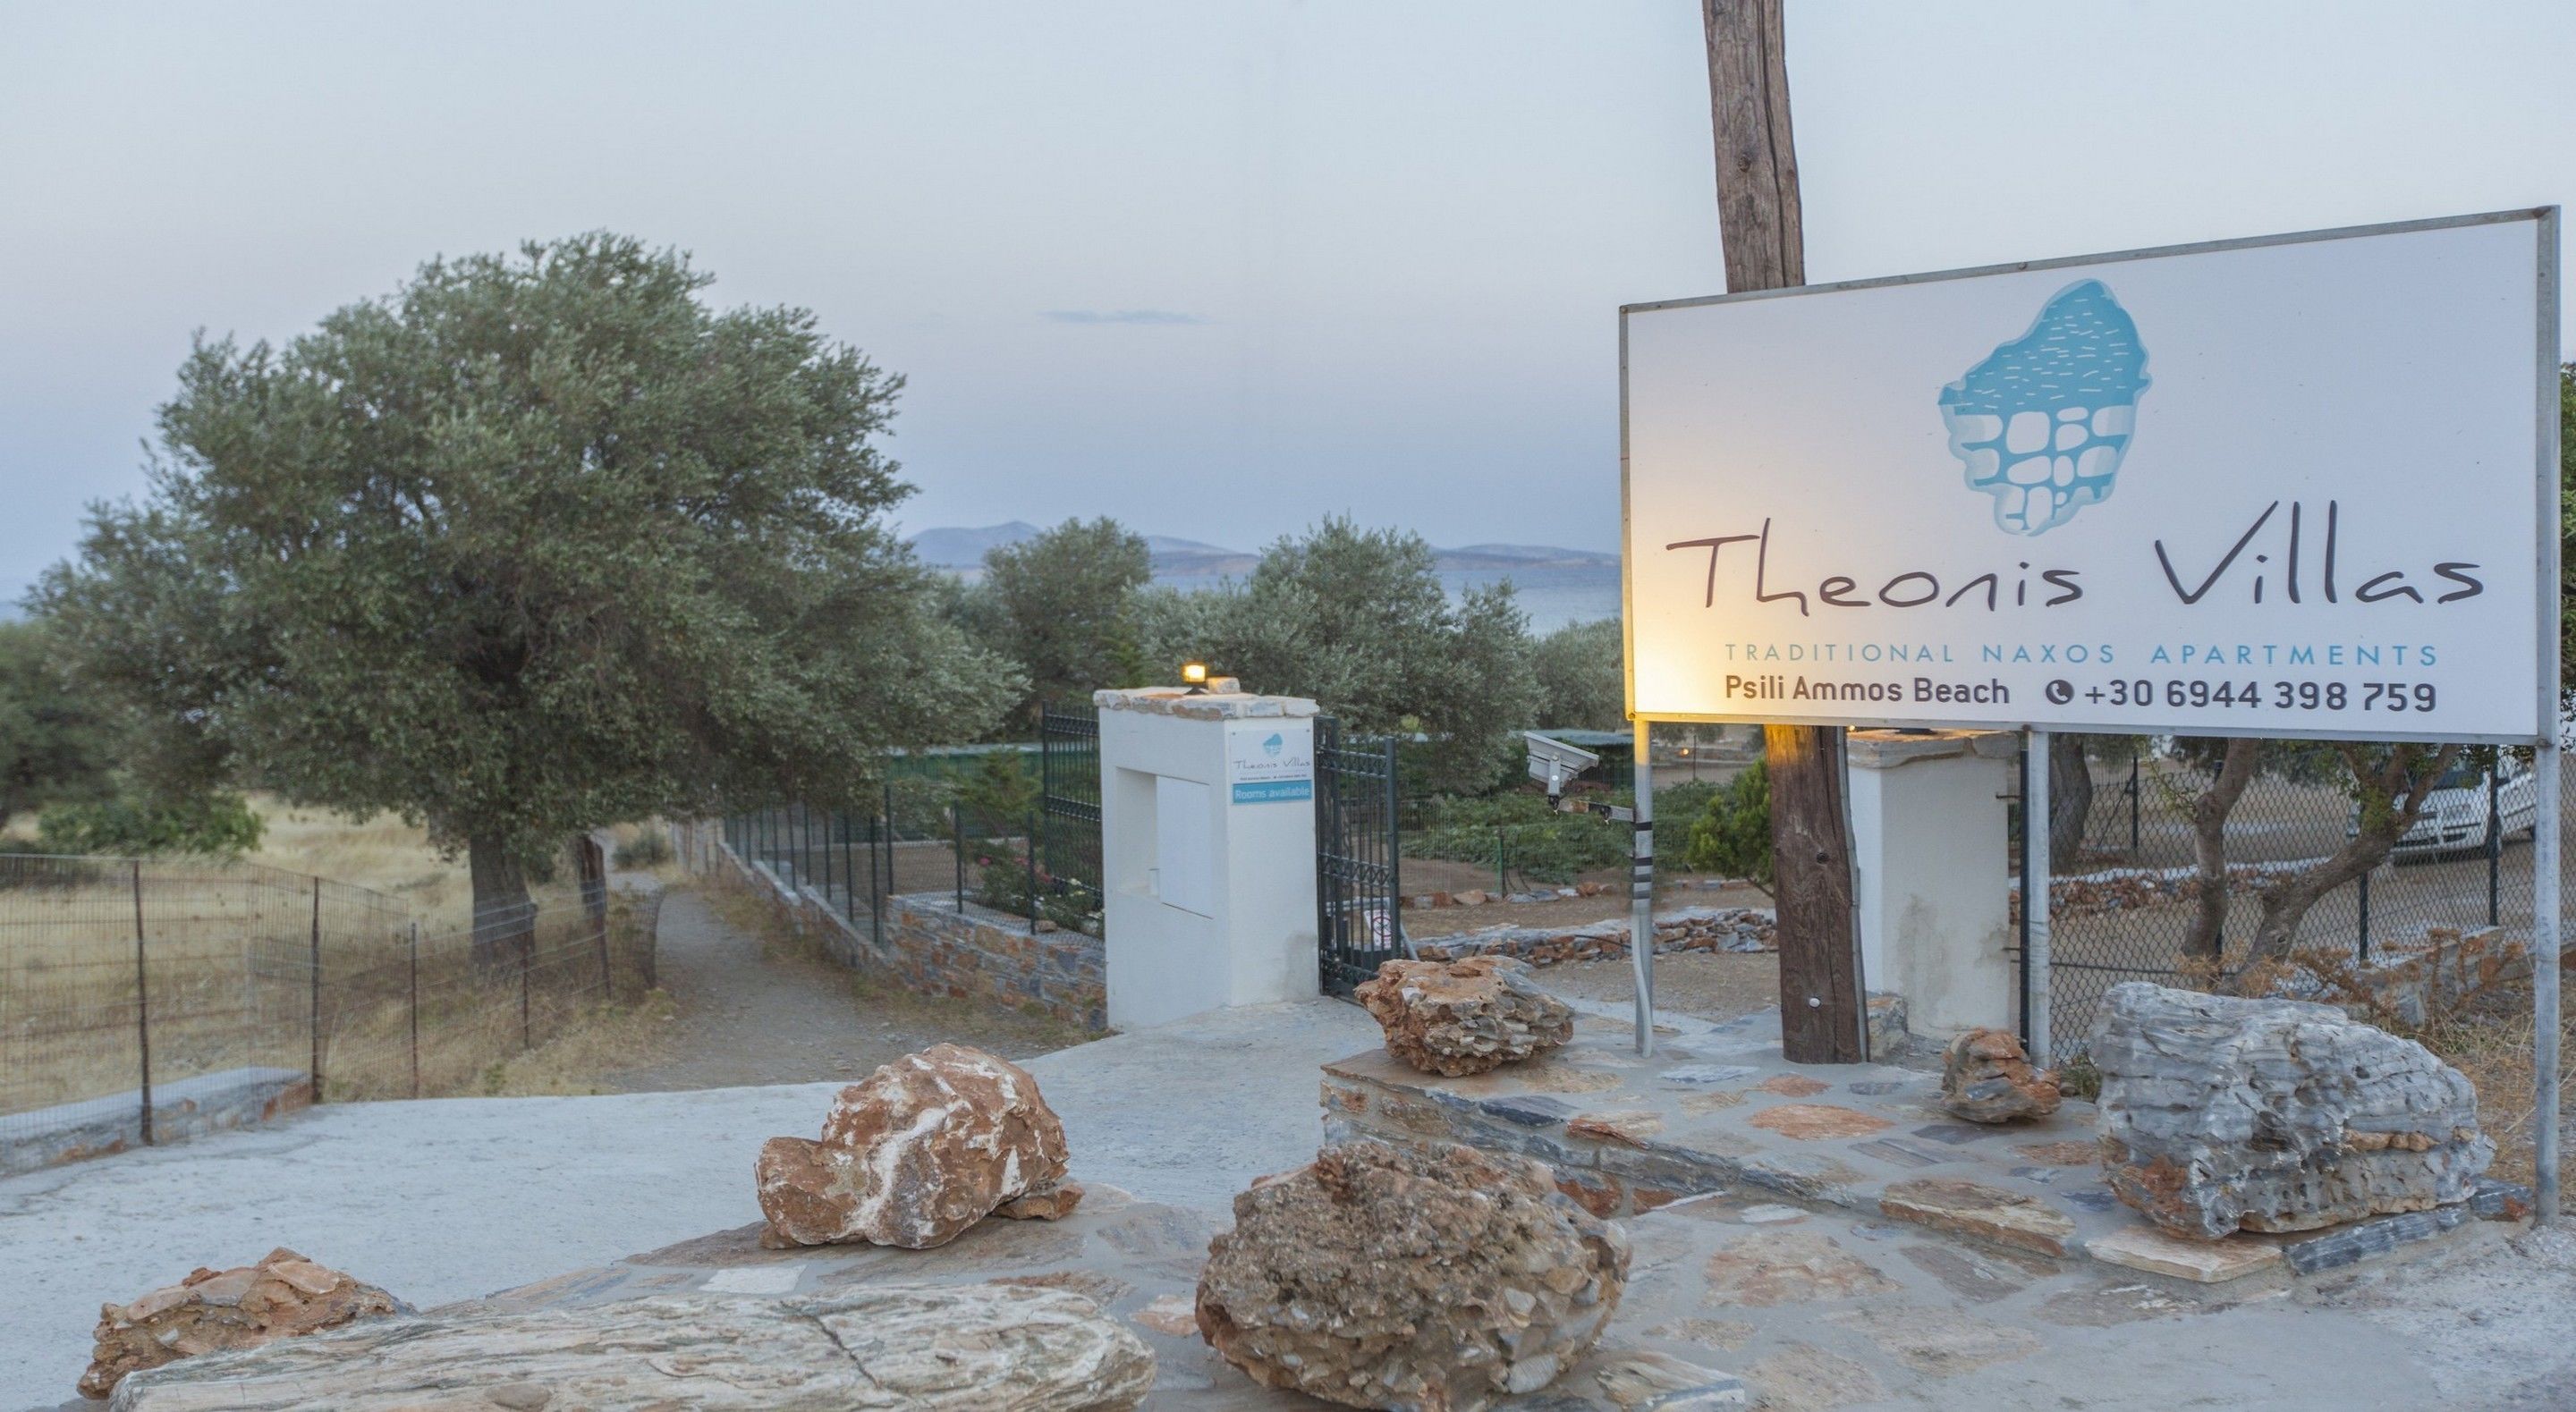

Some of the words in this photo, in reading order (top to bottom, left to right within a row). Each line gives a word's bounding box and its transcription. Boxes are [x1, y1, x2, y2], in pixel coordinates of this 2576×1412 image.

[1665, 517, 2083, 617] Theonis
[2154, 499, 2484, 605] Villas
[1725, 643, 1953, 663] TRADITIONAL
[1982, 644, 2114, 664] NAXOS
[2149, 644, 2437, 667] APARTMENTS
[1725, 674, 1784, 700] Psili
[1792, 675, 1903, 703] Ammos
[1913, 676, 2011, 705] Beach
[2083, 678, 2154, 707] +30
[2165, 679, 2263, 709] 6944
[2273, 680, 2349, 711] 398
[2362, 681, 2437, 714] 759
[1235, 790, 1267, 799] Rooms
[1268, 786, 1310, 798] available
